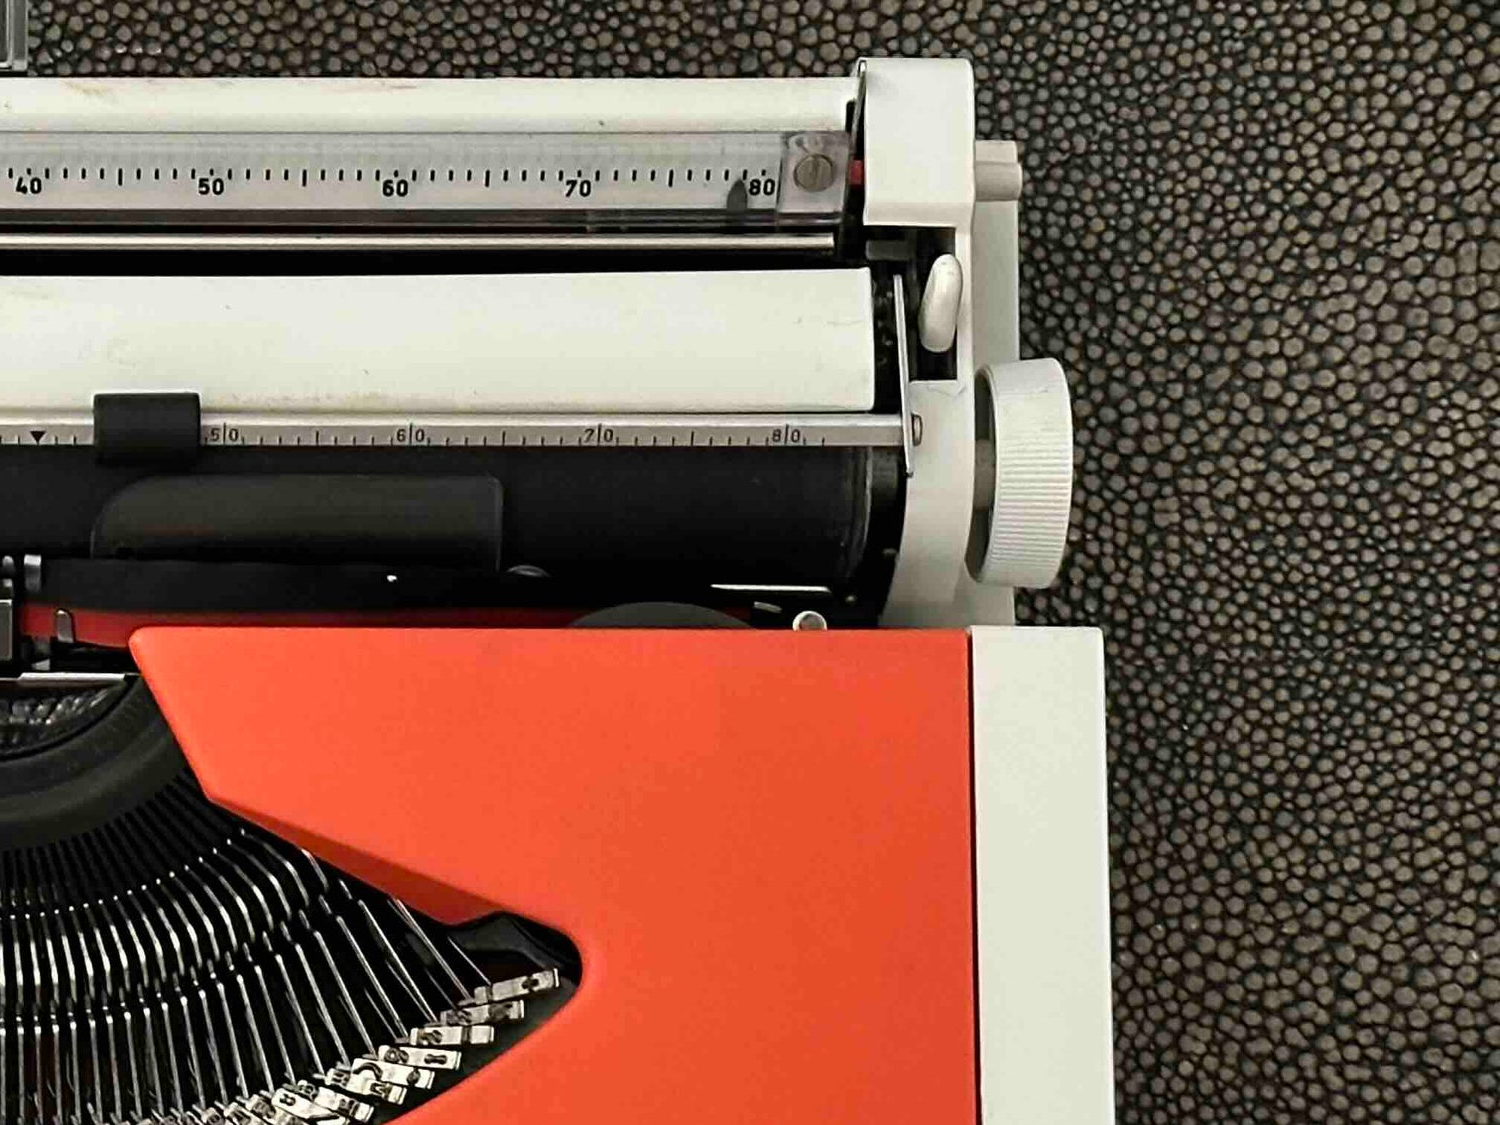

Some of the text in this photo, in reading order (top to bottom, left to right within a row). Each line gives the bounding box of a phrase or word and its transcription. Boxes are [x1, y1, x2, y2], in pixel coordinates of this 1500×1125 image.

[15, 177, 42, 195] 40
[198, 177, 225, 196] 50
[382, 178, 409, 198] 60
[565, 179, 592, 198] 70
[748, 178, 776, 198] 80
